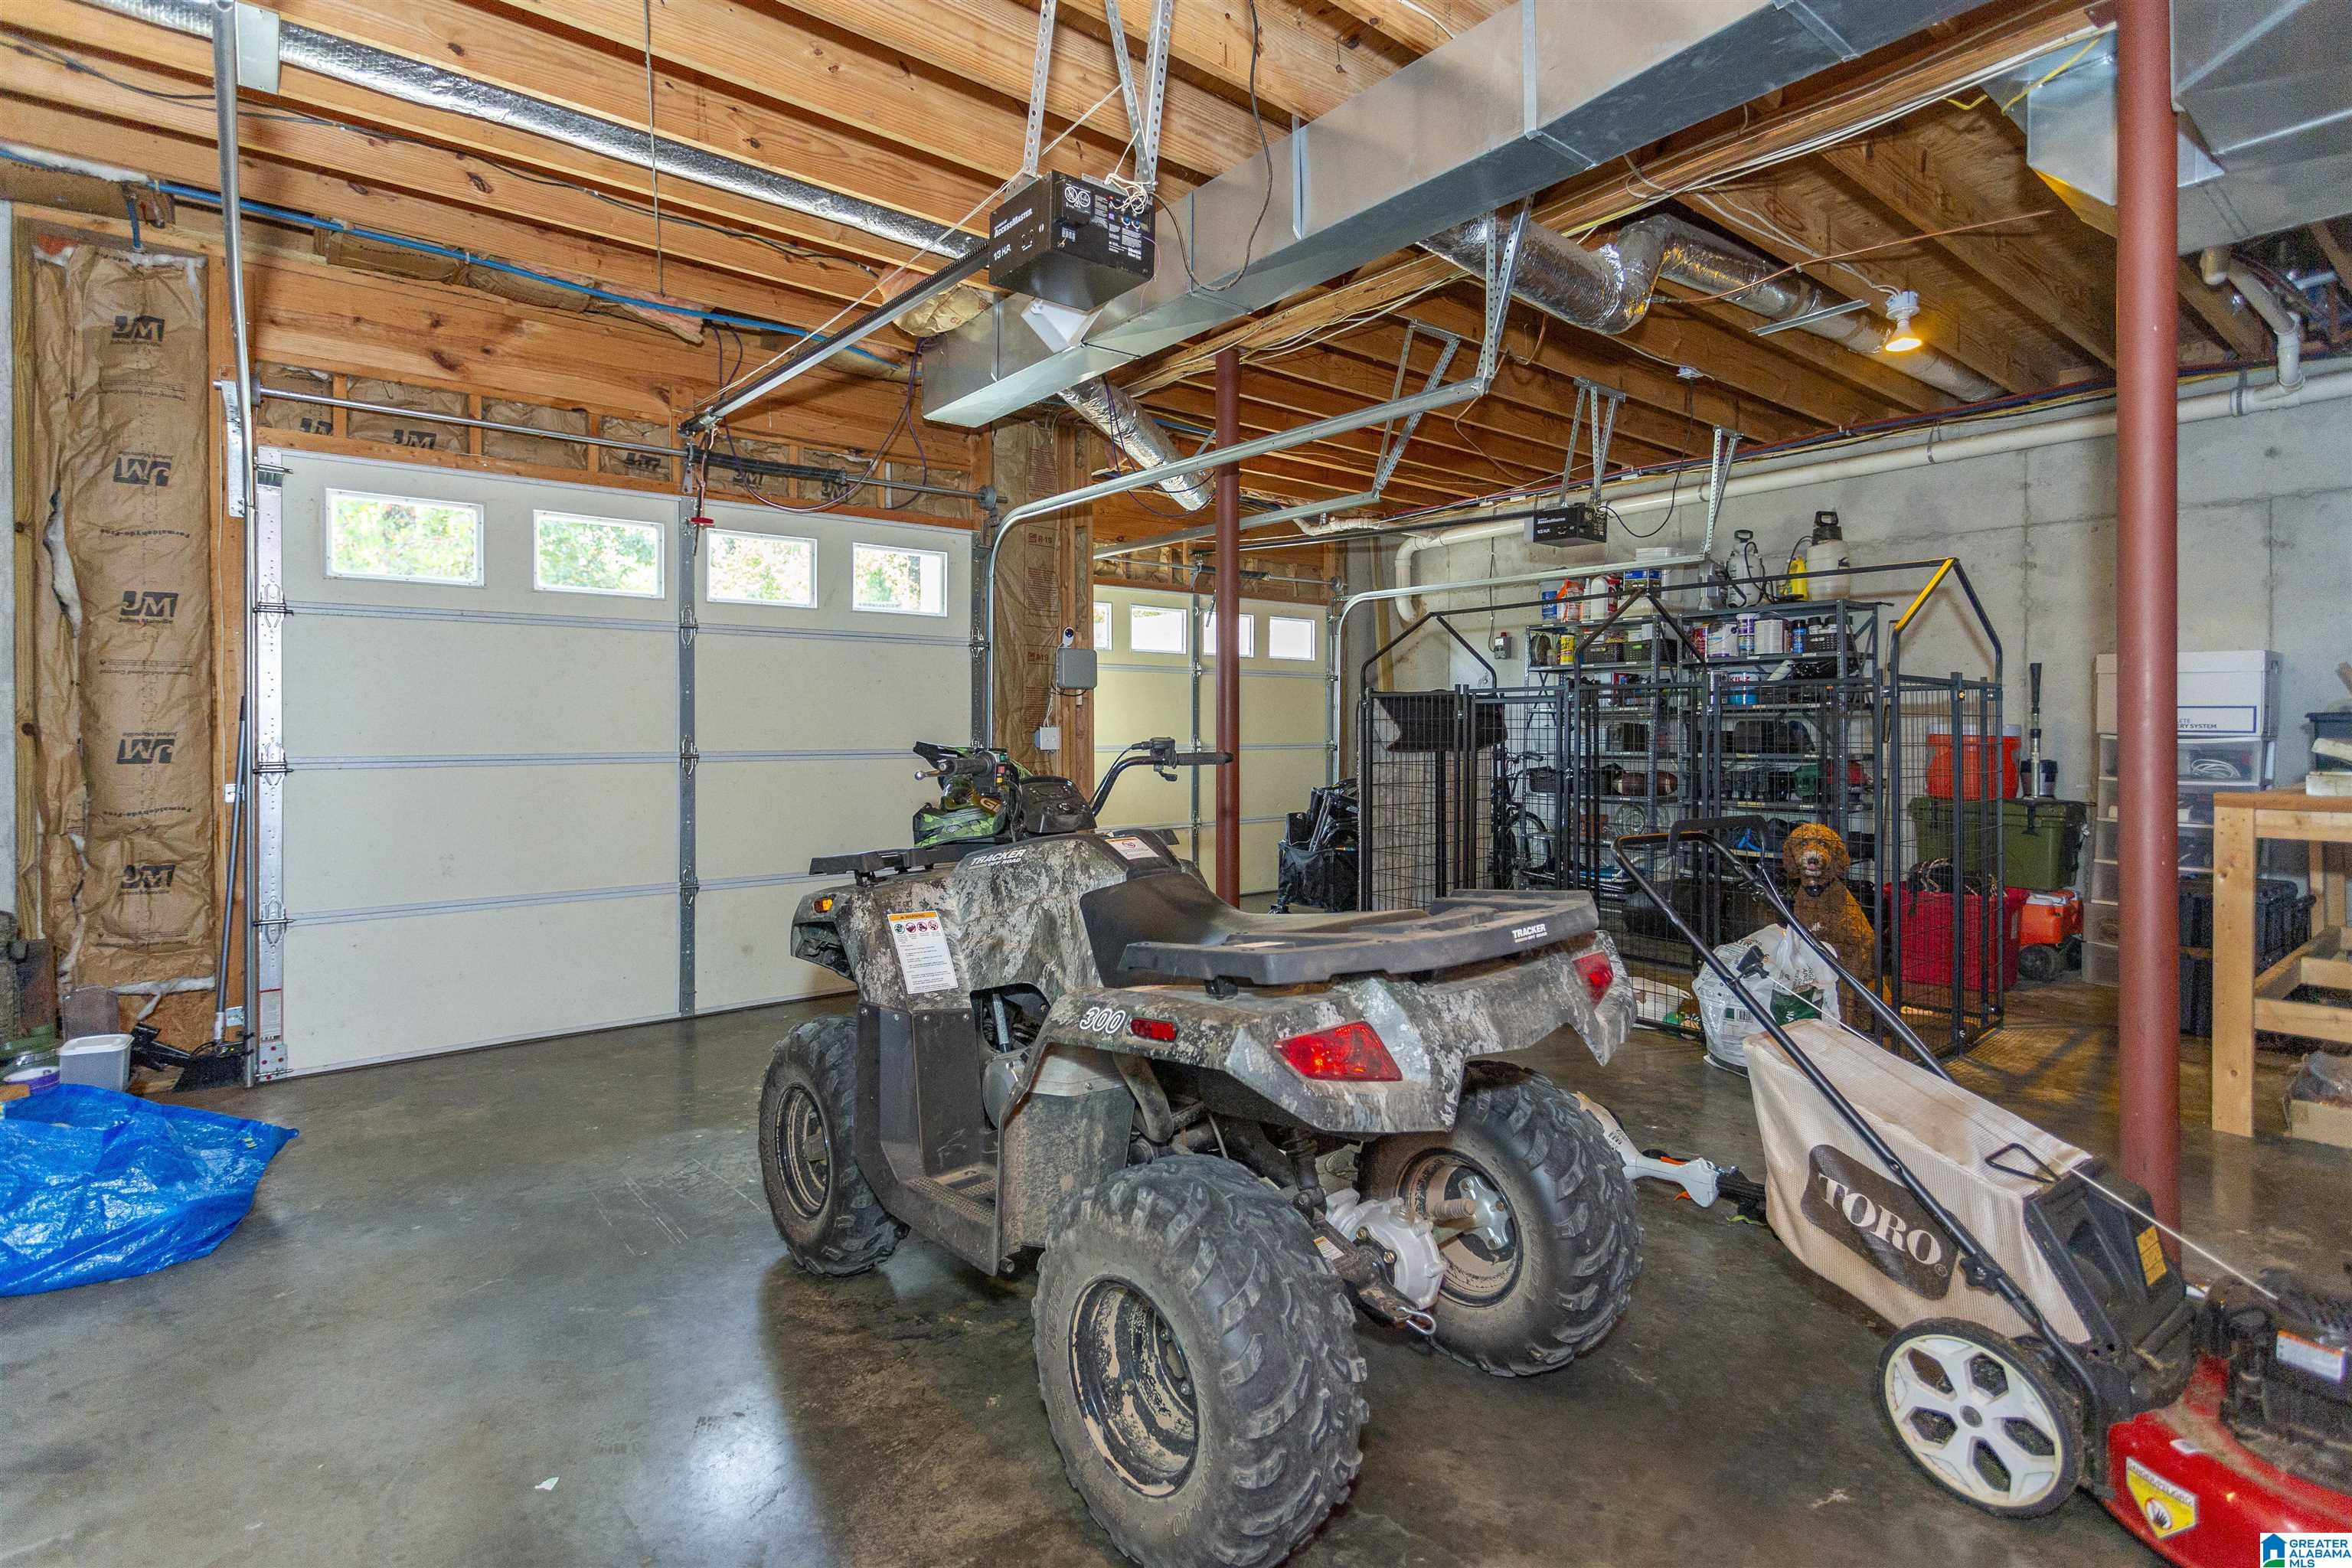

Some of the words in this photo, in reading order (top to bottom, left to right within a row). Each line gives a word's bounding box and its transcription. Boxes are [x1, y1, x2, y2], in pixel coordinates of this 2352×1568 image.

[113, 457, 172, 487] JM
[120, 590, 178, 617] JM
[116, 739, 175, 764] JM
[970, 848, 1027, 866] TRACKER
[1511, 923, 1547, 939] TRACKER
[1079, 1007, 1126, 1034] 300
[1818, 1171, 1942, 1266] TORO
